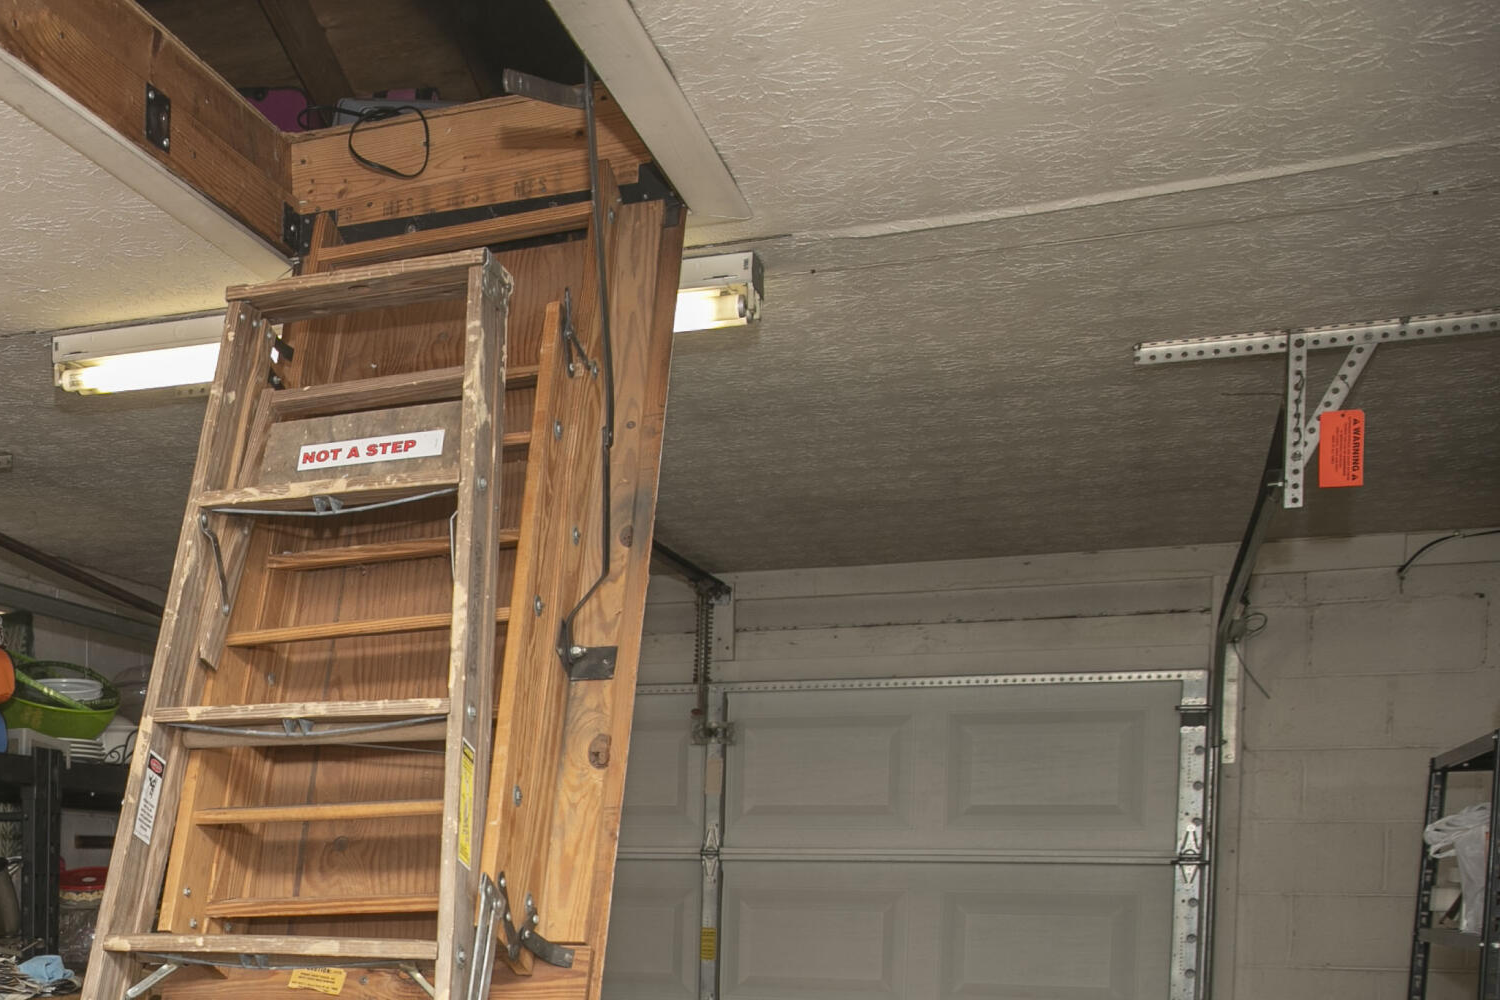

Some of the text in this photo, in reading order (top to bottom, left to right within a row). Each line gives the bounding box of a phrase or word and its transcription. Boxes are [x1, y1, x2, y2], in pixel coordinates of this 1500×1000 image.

[302, 438, 417, 465] NOT A STEP
[1352, 427, 1361, 472] WARNING
